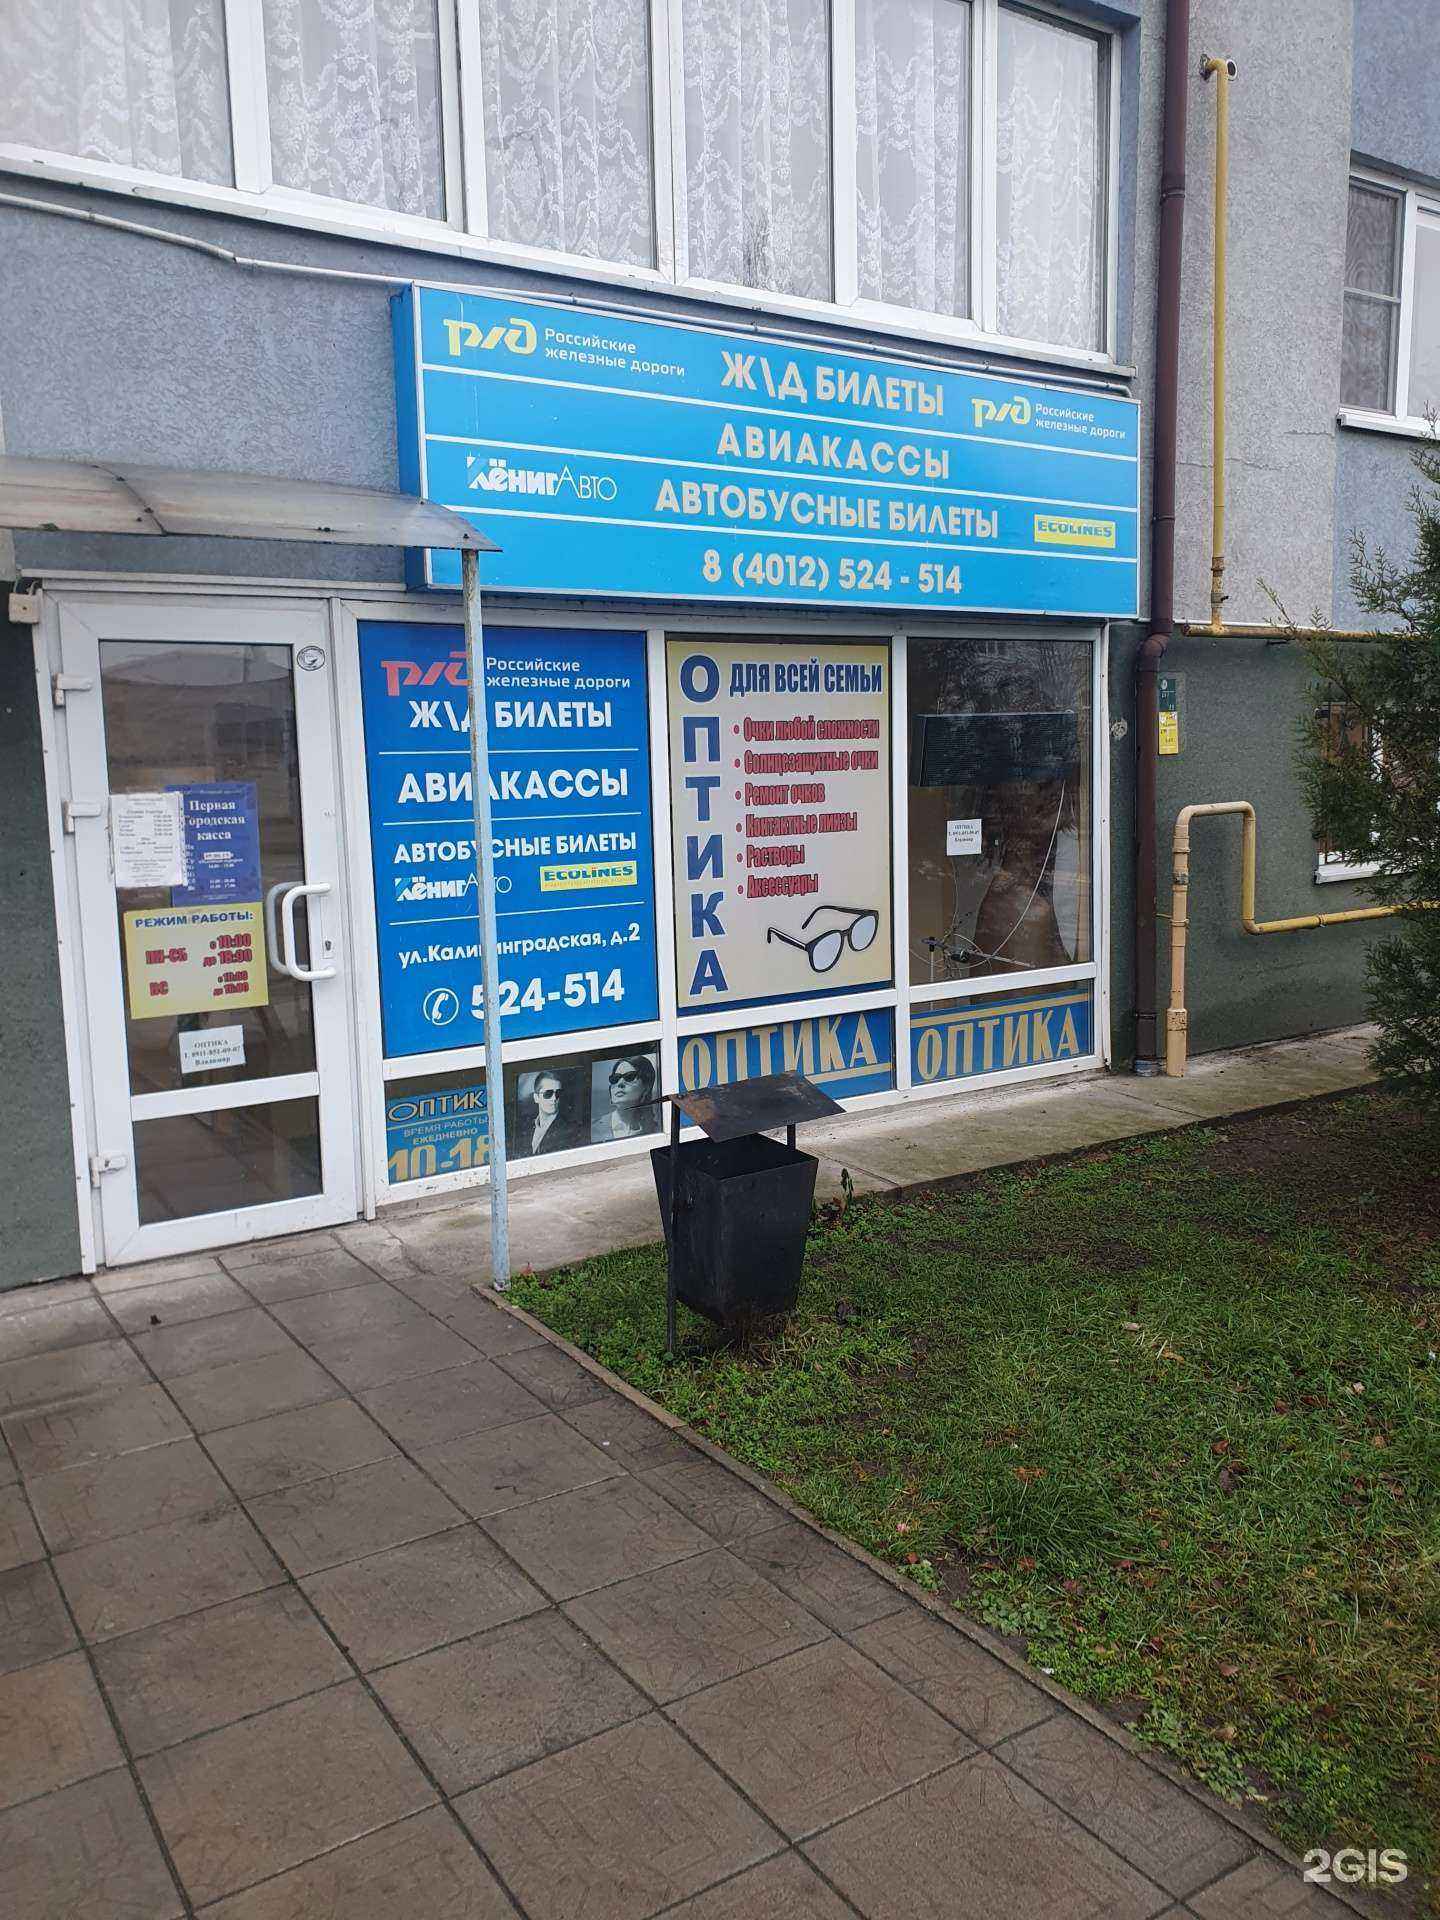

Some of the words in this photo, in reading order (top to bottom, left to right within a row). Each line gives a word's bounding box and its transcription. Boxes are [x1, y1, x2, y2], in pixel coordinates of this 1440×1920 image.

[545, 328, 636, 353] Российские
[545, 348, 626, 369] железные
[630, 359, 685, 377] дороги
[720, 350, 808, 403] Ж\Д
[816, 366, 944, 416] БИЛЕТЫ
[1035, 403, 1095, 422] Российские
[1035, 417, 1088, 435] железные
[1090, 424, 1126, 440] дороги
[717, 423, 949, 480] АВИАКАССЫ
[655, 479, 881, 530] АВТОБУСНЫЕ
[888, 501, 998, 539] БИЛЕТЫ
[702, 549, 721, 582] 8
[732, 551, 829, 592] (4012)
[838, 559, 891, 591] 524
[918, 563, 963, 595] 514
[486, 657, 580, 673] Российские
[486, 675, 570, 688] железные
[574, 677, 631, 691] дороги
[729, 663, 770, 697] ДЛЯ
[774, 659, 820, 693] ВСЕЙ
[824, 664, 883, 693] СЕМЬИ
[495, 701, 612, 729] БИЛЕТЫ
[744, 717, 774, 742] Очки
[775, 715, 816, 740] любой
[817, 719, 880, 740] сложности
[744, 750, 850, 776] Солнцезащитные
[851, 751, 878, 770] очки
[189, 800, 236, 812] Первая
[745, 782, 789, 806] Ремонт
[790, 783, 825, 804] очков
[197, 832, 232, 841] касса
[679, 654, 729, 996] ОПТИКА
[746, 814, 817, 837] Контактные
[818, 812, 858, 833] линзы
[556, 832, 637, 855] БИЛЕТЫ
[747, 845, 805, 868] Растворы
[747, 874, 818, 898] Аксессуары
[135, 915, 187, 928] РЕЖИМ
[191, 911, 253, 924] РАБОТЫ:
[611, 923, 641, 944] д.2
[471, 968, 625, 1020] 524-514
[681, 1013, 878, 1091] ОПТИКА
[917, 1007, 1080, 1082] ОПТИКА
[404, 1124, 440, 1137] ВРЕМЯ
[414, 1128, 478, 1145] ЕЖЕДНЕВНО
